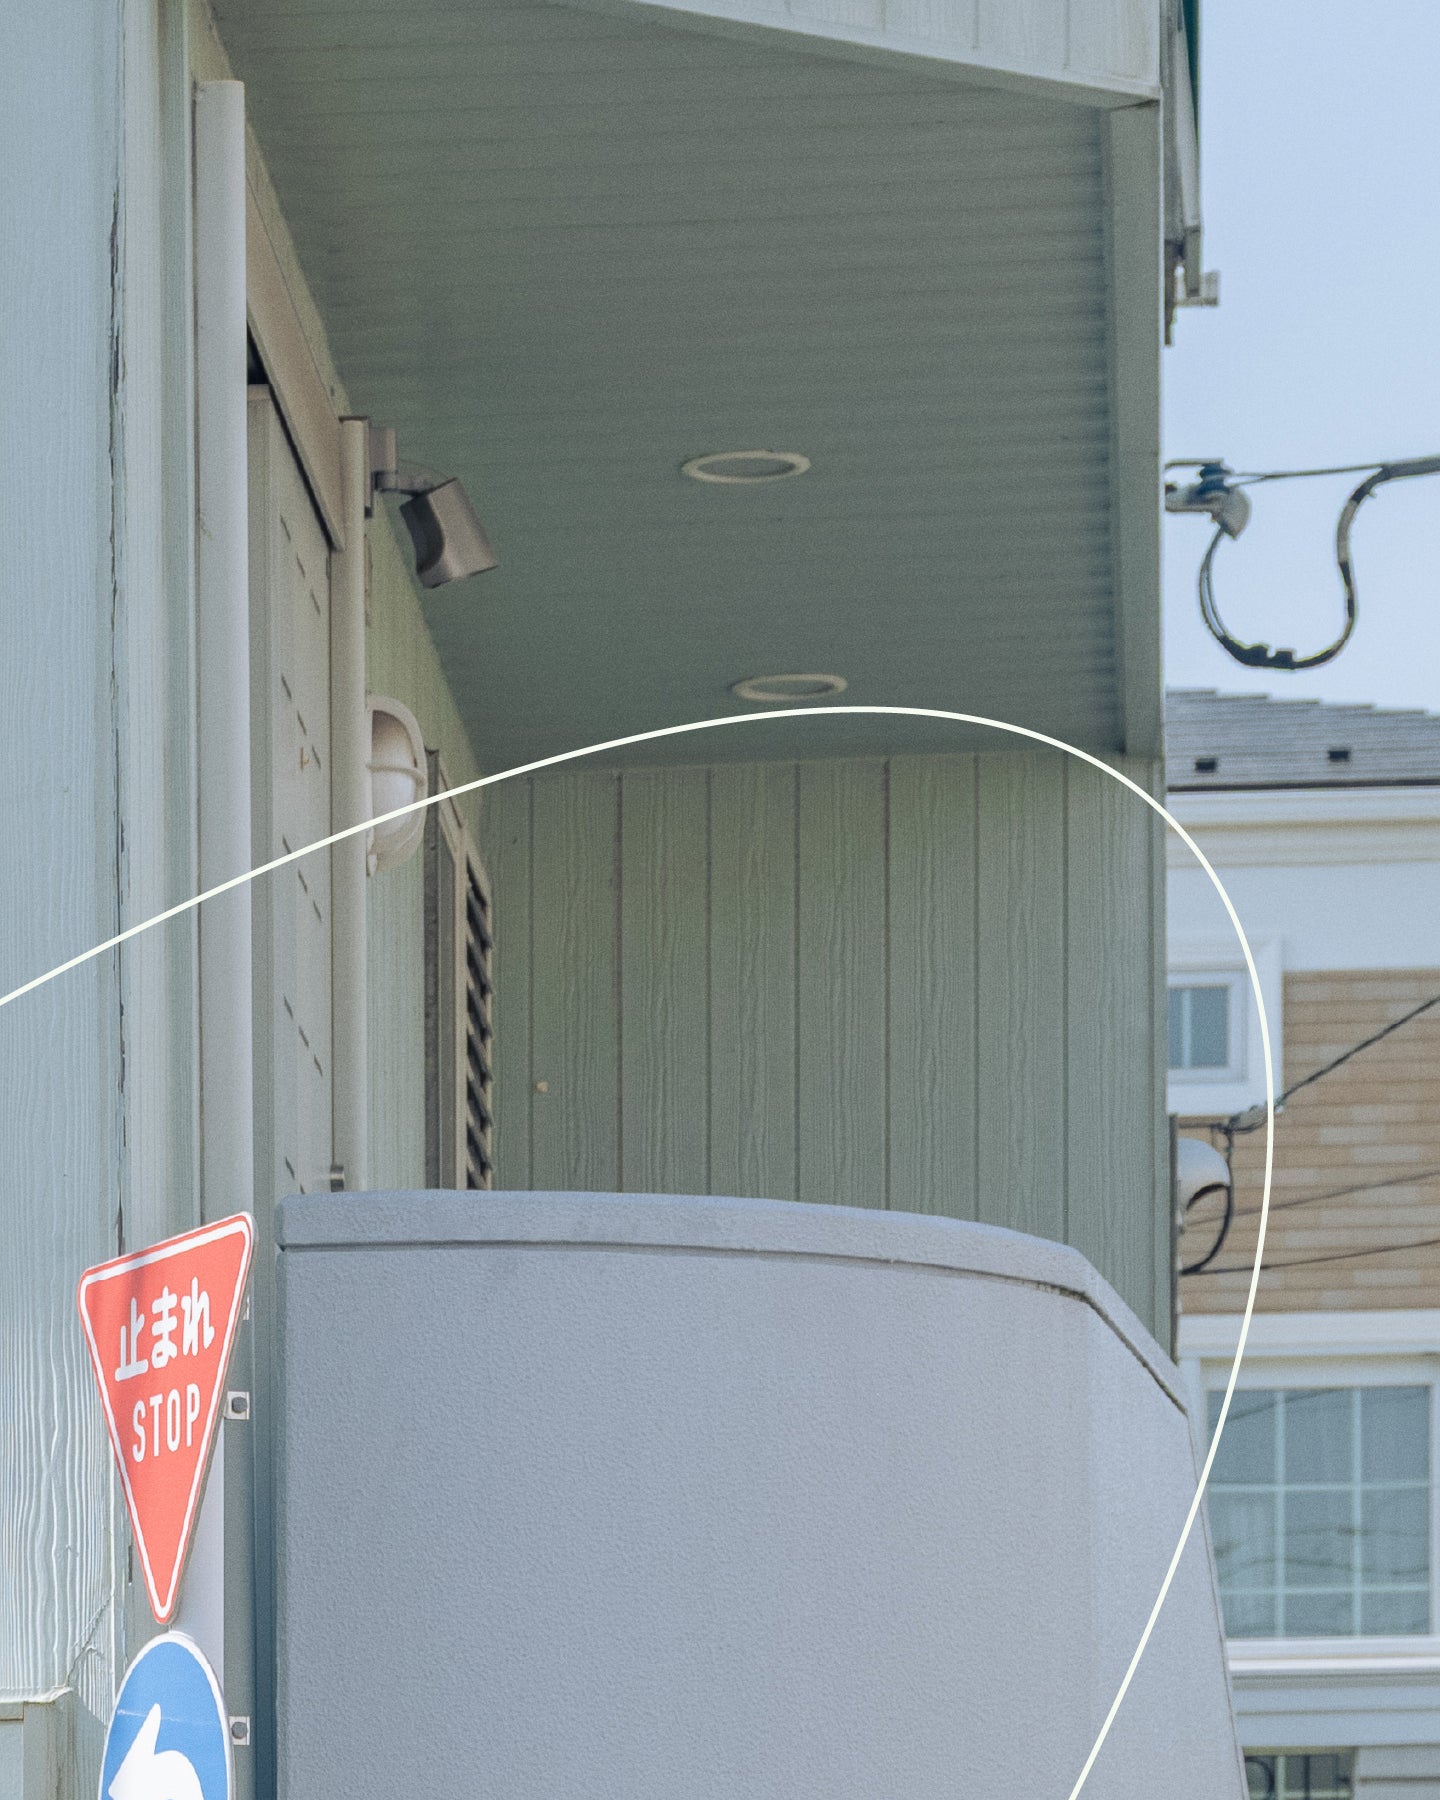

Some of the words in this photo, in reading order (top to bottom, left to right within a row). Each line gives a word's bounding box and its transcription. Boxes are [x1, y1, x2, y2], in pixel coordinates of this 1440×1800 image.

[114, 1276, 216, 1382] 止まれ
[132, 1383, 201, 1463] STOP
